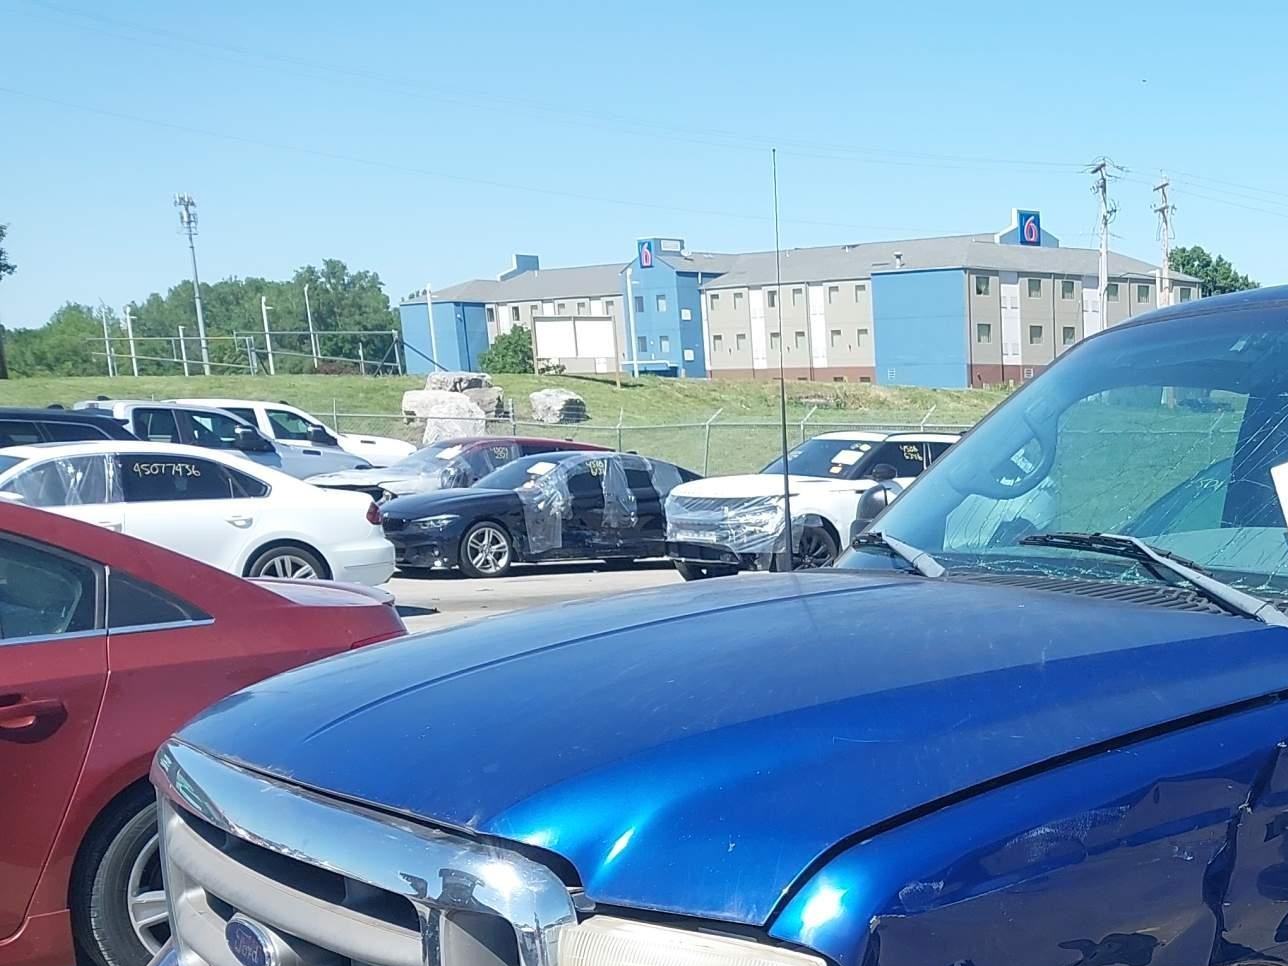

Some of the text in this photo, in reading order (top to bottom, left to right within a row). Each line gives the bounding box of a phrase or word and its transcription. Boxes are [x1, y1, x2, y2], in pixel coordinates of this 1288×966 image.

[1024, 215, 1038, 242] 6
[641, 241, 652, 266] 6
[234, 926, 261, 964] Ford
